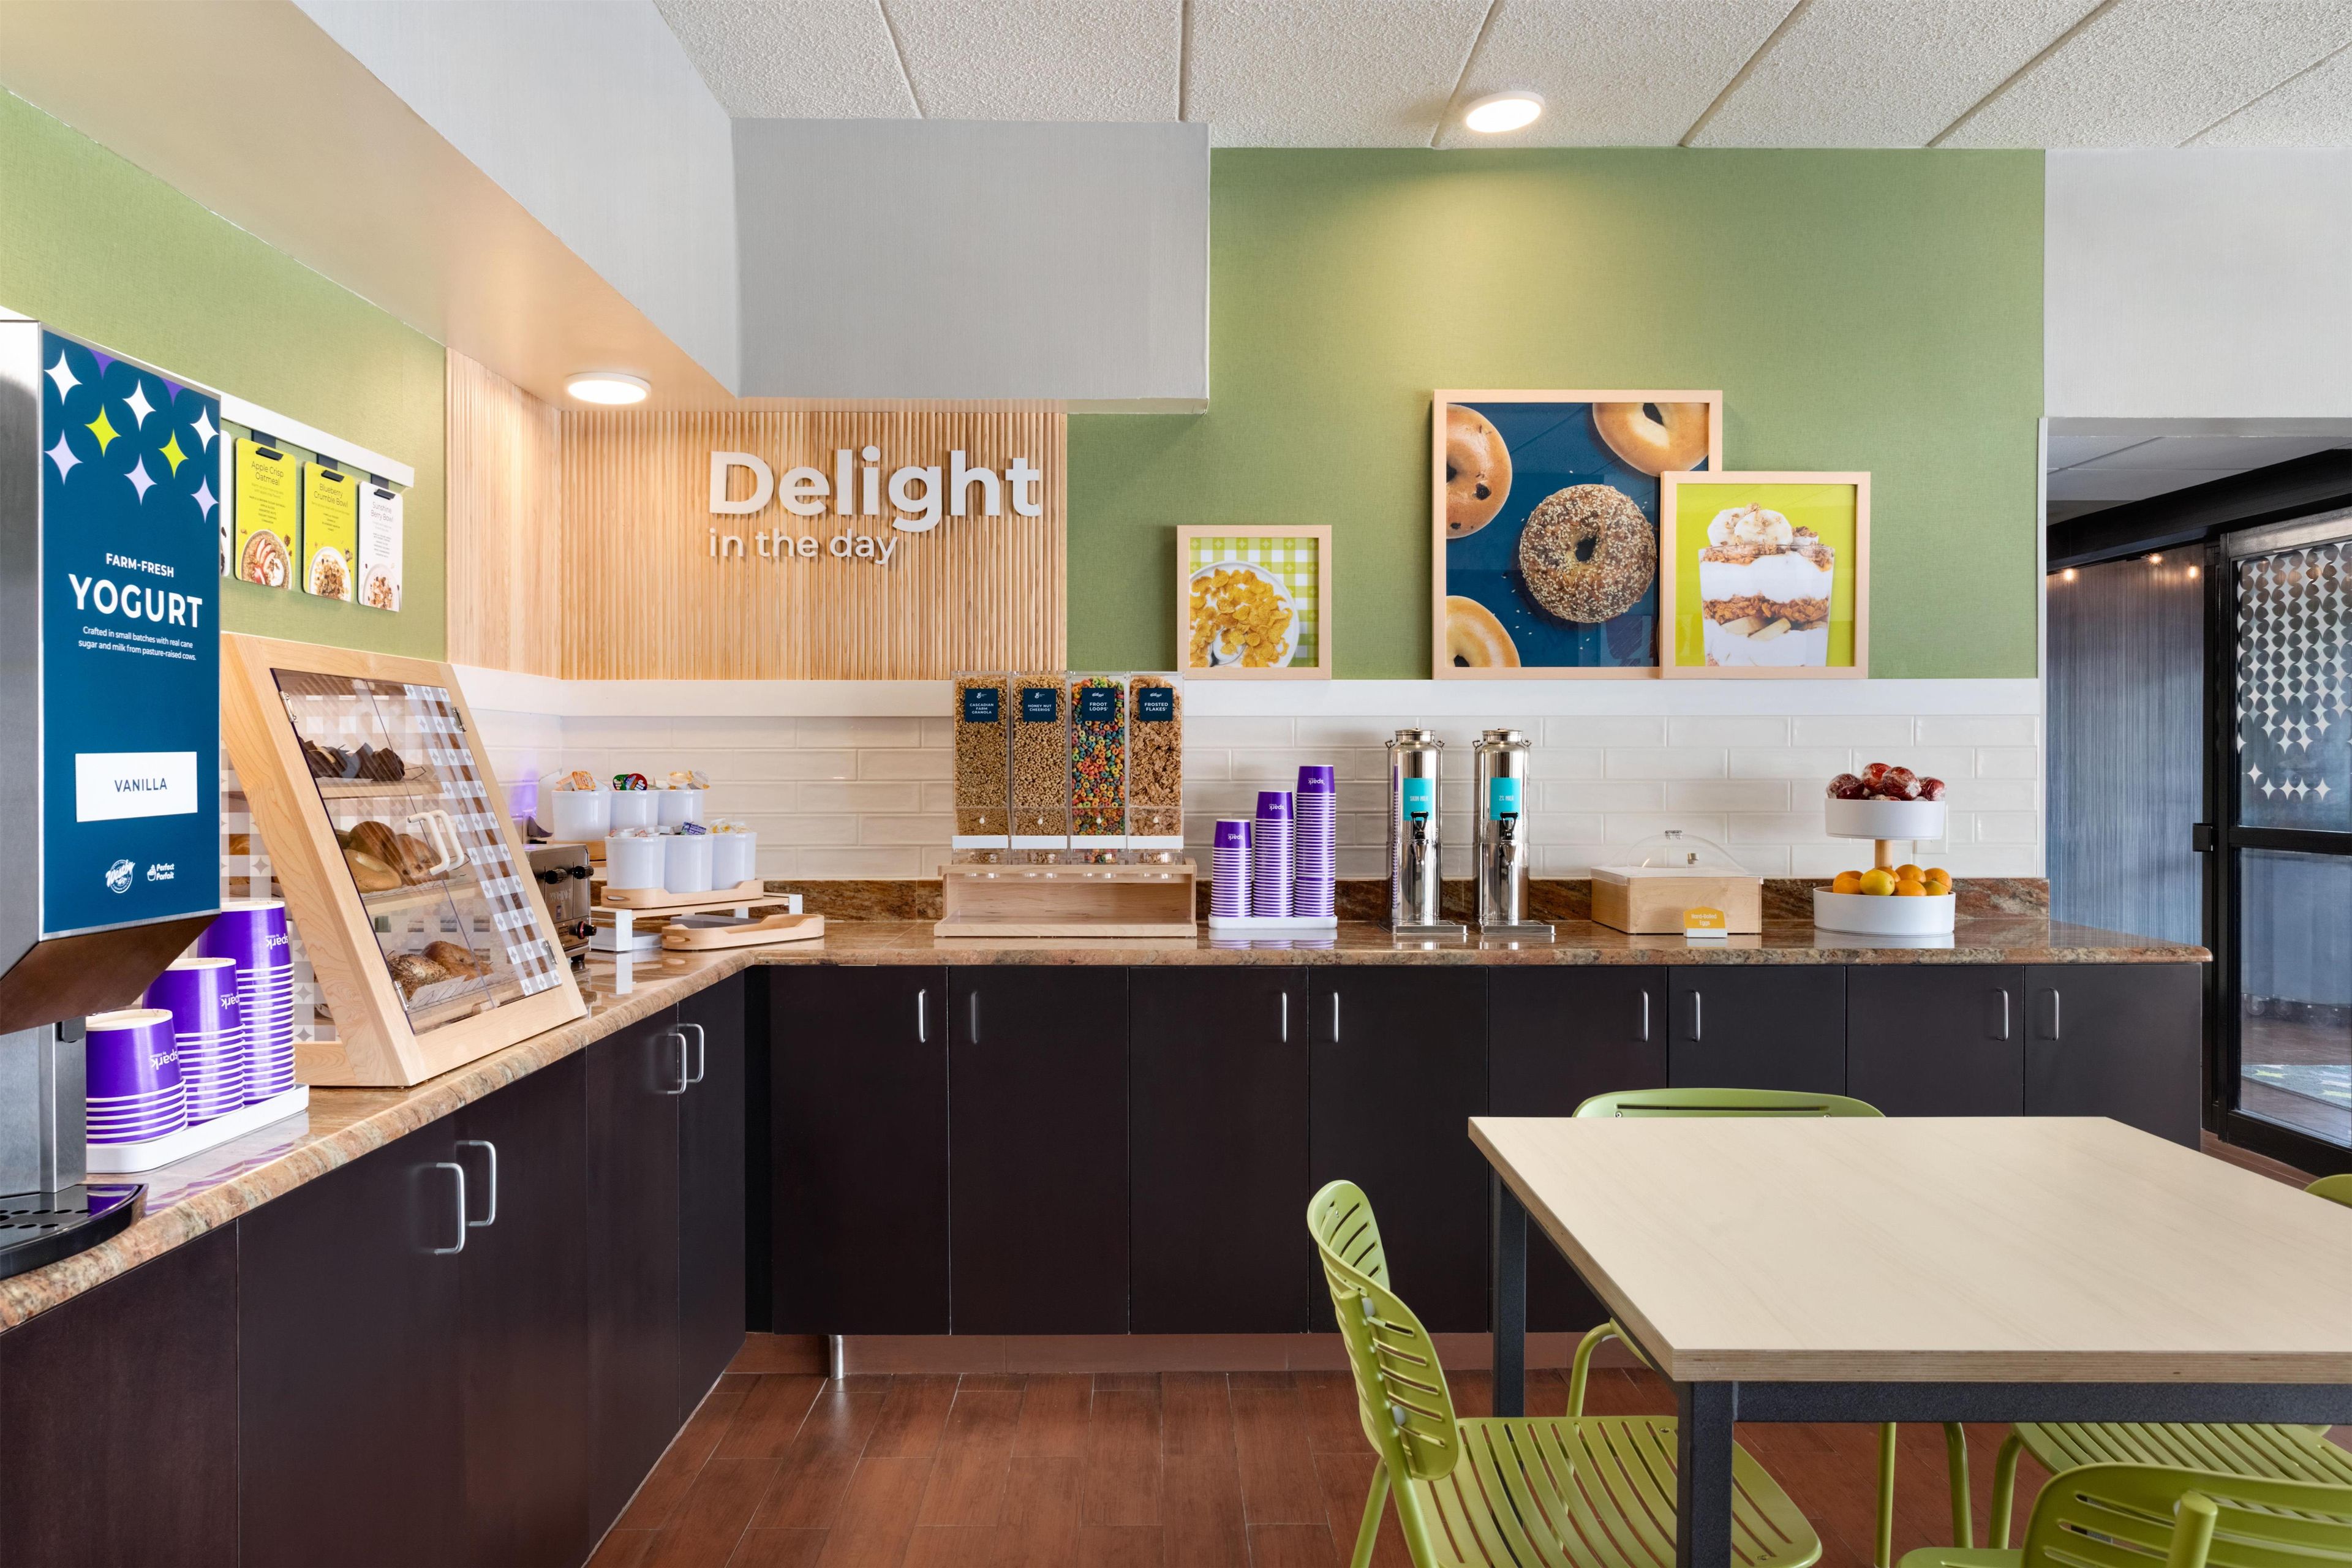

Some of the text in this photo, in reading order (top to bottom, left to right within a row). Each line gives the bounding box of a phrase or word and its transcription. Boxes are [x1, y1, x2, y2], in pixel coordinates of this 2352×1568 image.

[251, 461, 284, 478] Apple Crisp
[255, 472, 280, 486] Oatmeal
[319, 483, 342, 499] Blueberry
[709, 445, 1042, 532] Delight
[314, 491, 349, 508] Crumble Bowl
[372, 501, 392, 514] Sunshine
[371, 510, 382, 521] Berry
[709, 527, 898, 565] in the day
[105, 552, 175, 578] FARM-FRESH
[68, 573, 203, 628] YOGURT
[83, 626, 108, 636] Crafted
[108, 629, 115, 638] in
[115, 631, 132, 640] small
[132, 633, 156, 643] batches
[78, 640, 98, 650] sugar
[112, 643, 126, 652] milk
[126, 644, 141, 654] from
[142, 647, 181, 659] pasture-raised
[115, 778, 167, 793] VANILLA
[156, 872, 175, 880] Parfait
[157, 863, 175, 872] Perfect
[265, 933, 288, 950] spark
[221, 992, 240, 1010] park
[150, 1048, 178, 1071] spark
